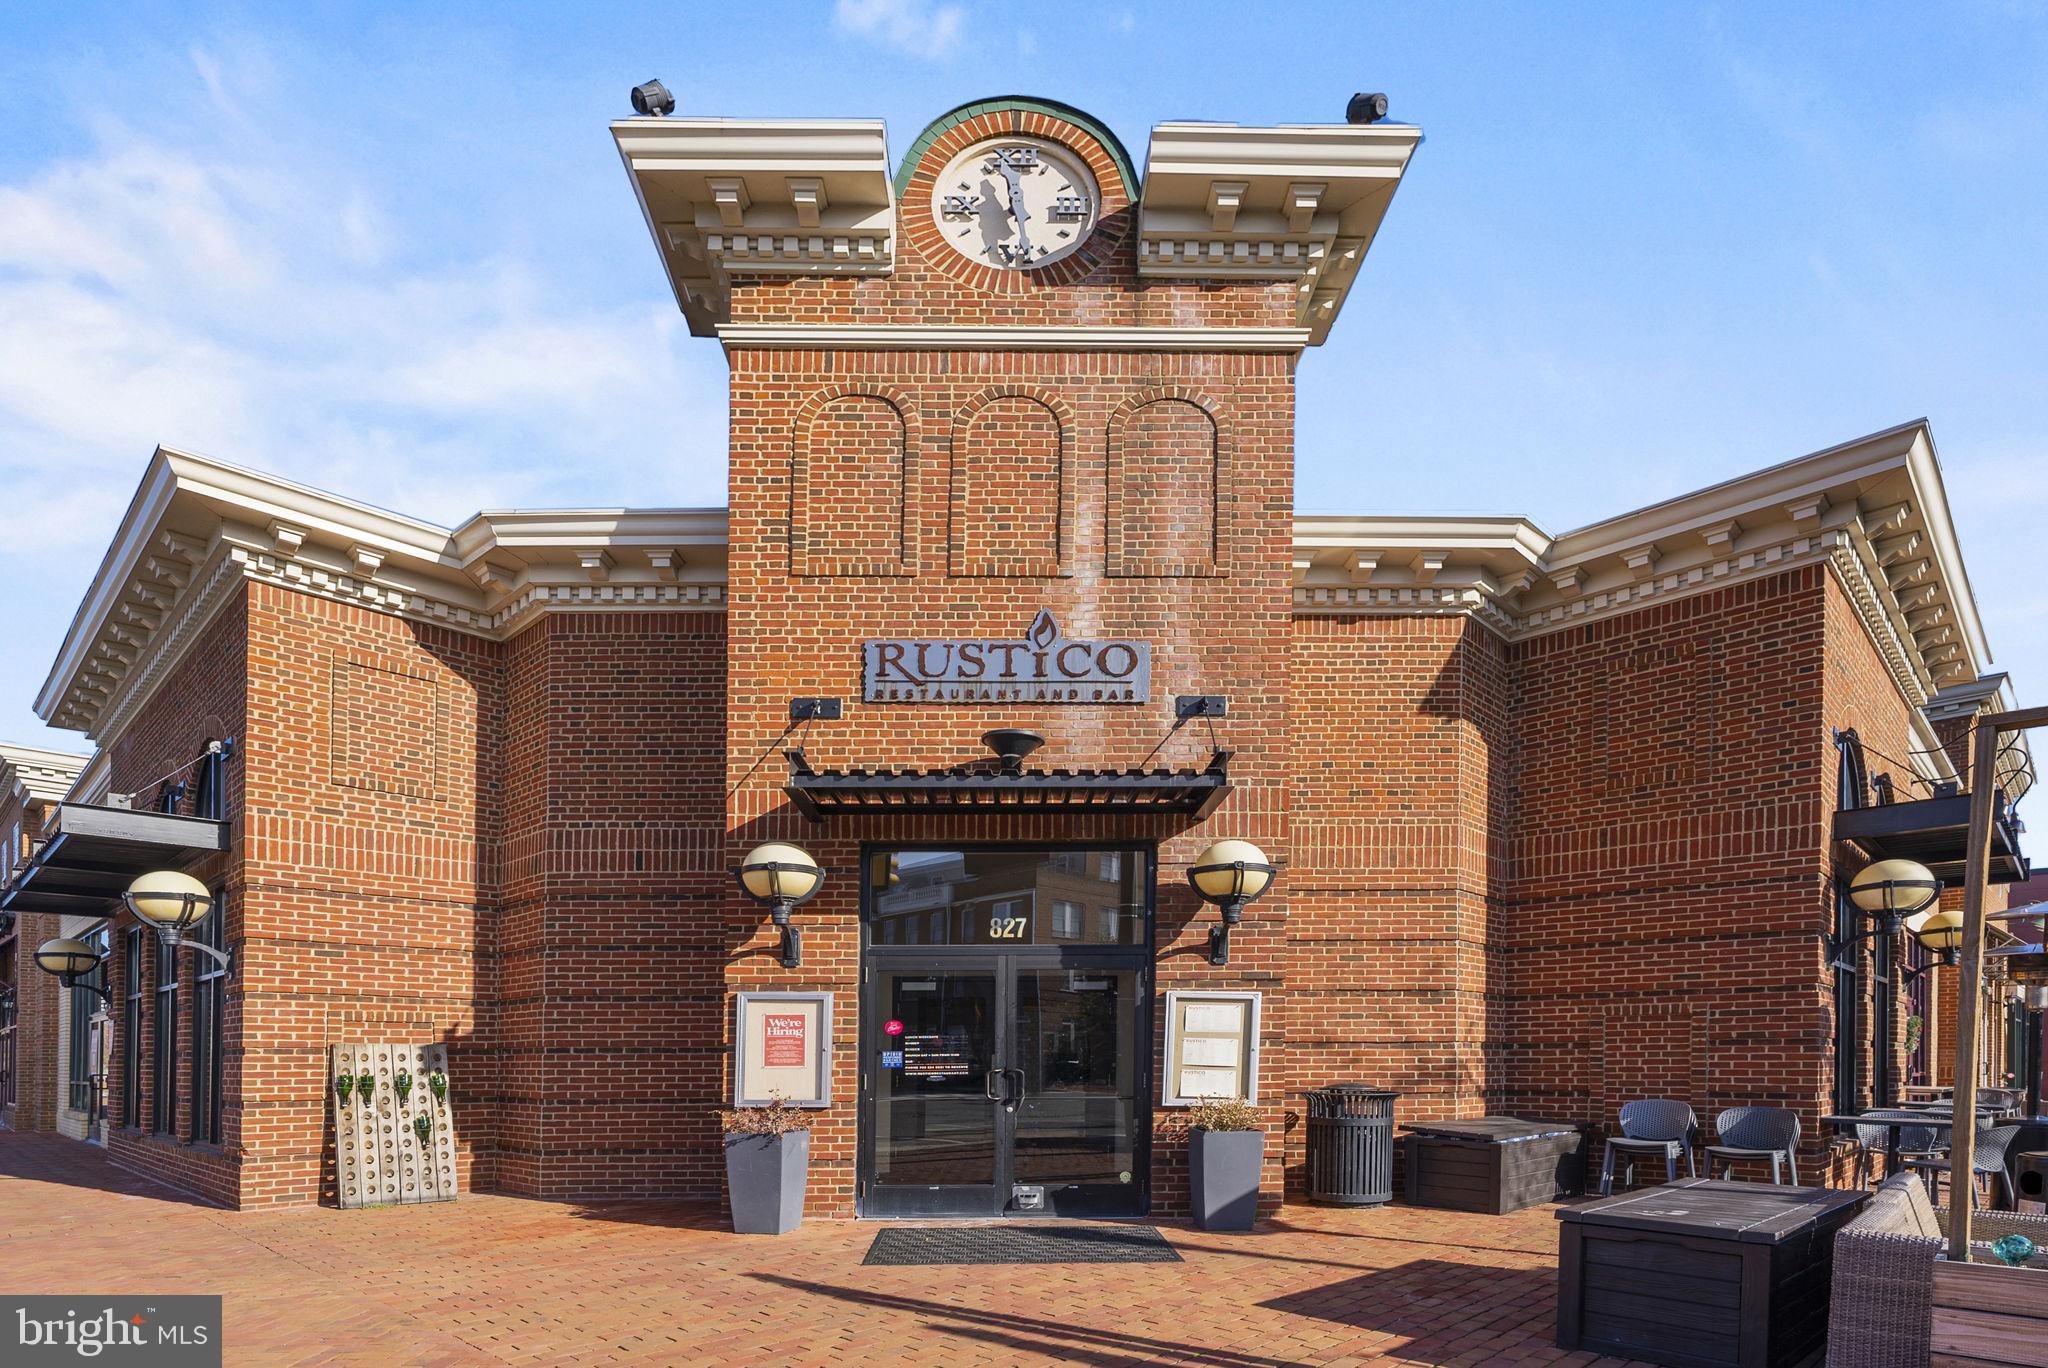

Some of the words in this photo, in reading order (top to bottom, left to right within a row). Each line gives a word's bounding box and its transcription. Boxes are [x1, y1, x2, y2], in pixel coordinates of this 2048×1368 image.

[993, 148, 1039, 167] XII
[944, 196, 980, 214] IX
[1057, 197, 1088, 215] III
[874, 688, 1021, 700] RESTAURANT
[1036, 688, 1079, 700] AND
[1092, 688, 1135, 700] BAR
[990, 918, 1026, 938] 827
[768, 1018, 802, 1027] We're
[767, 1027, 804, 1038] Hiring
